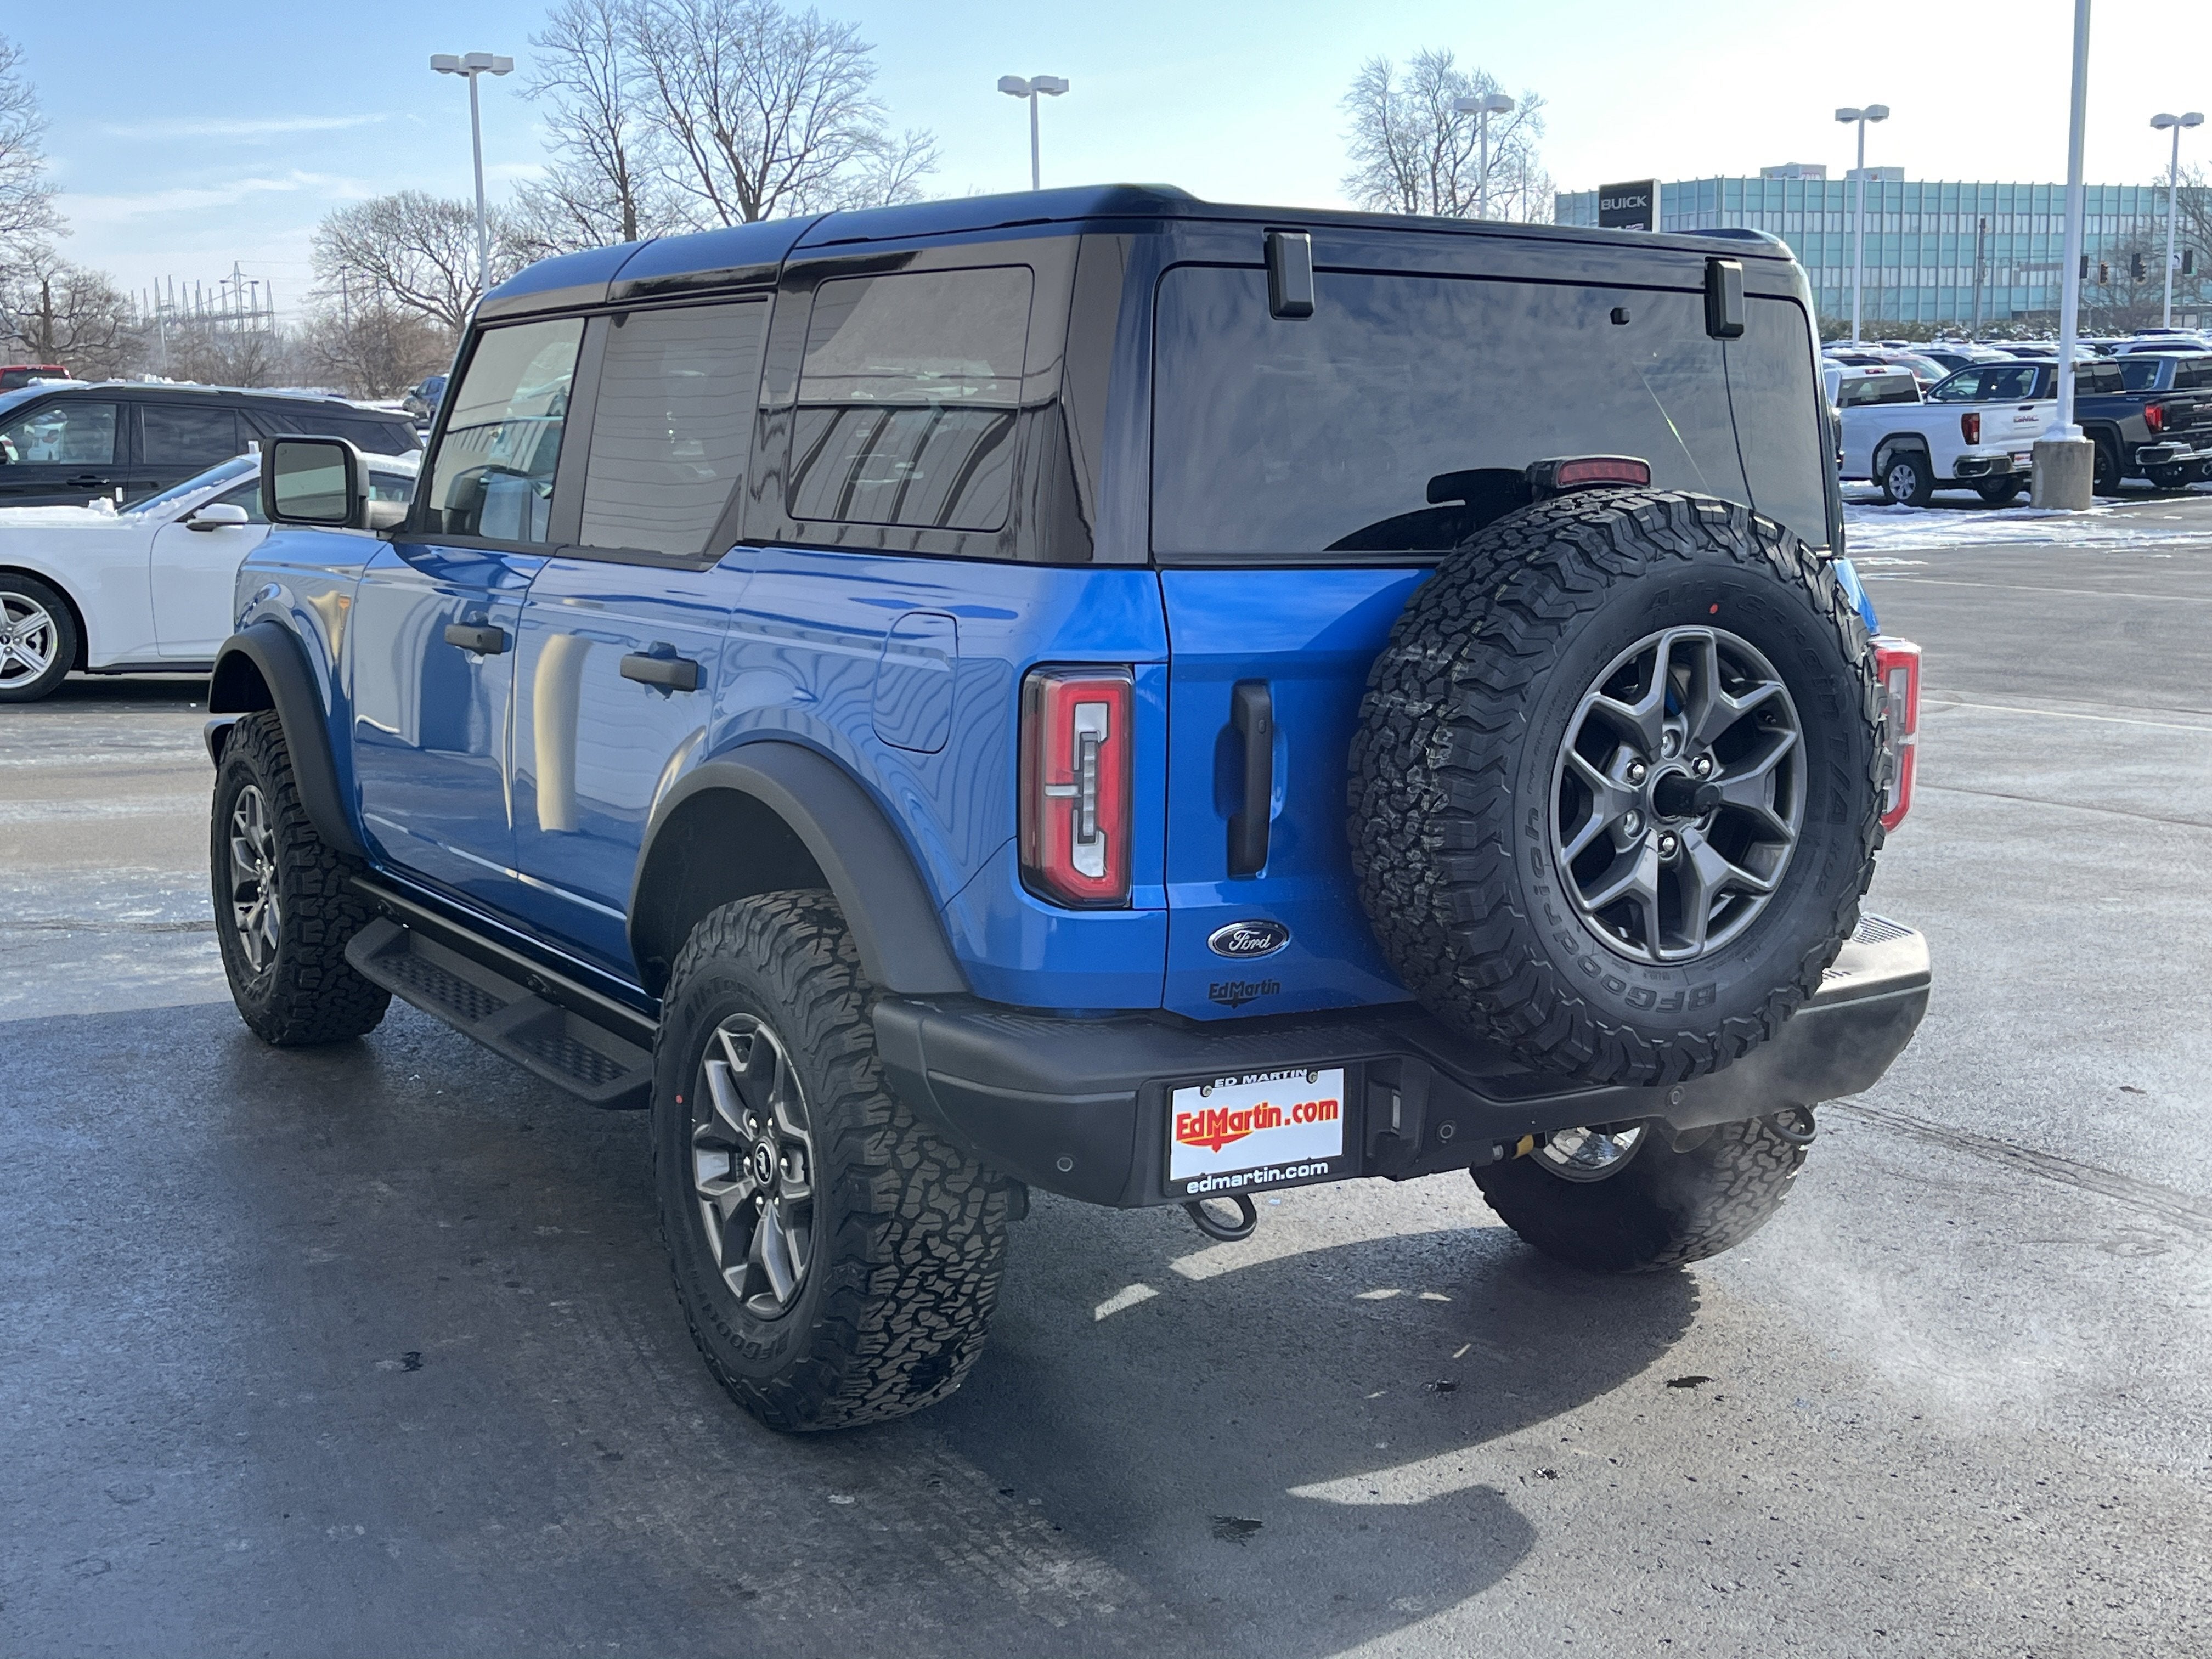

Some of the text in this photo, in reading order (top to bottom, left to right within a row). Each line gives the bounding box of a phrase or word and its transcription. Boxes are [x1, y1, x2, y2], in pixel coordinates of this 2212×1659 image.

[1601, 195, 1647, 210] BUICK
[1229, 930, 1271, 951] Ford
[1214, 1069, 1308, 1088] ED MARTIN
[1176, 1099, 1338, 1141] EdMartin.com
[1187, 1162, 1328, 1194] edmartin.com
